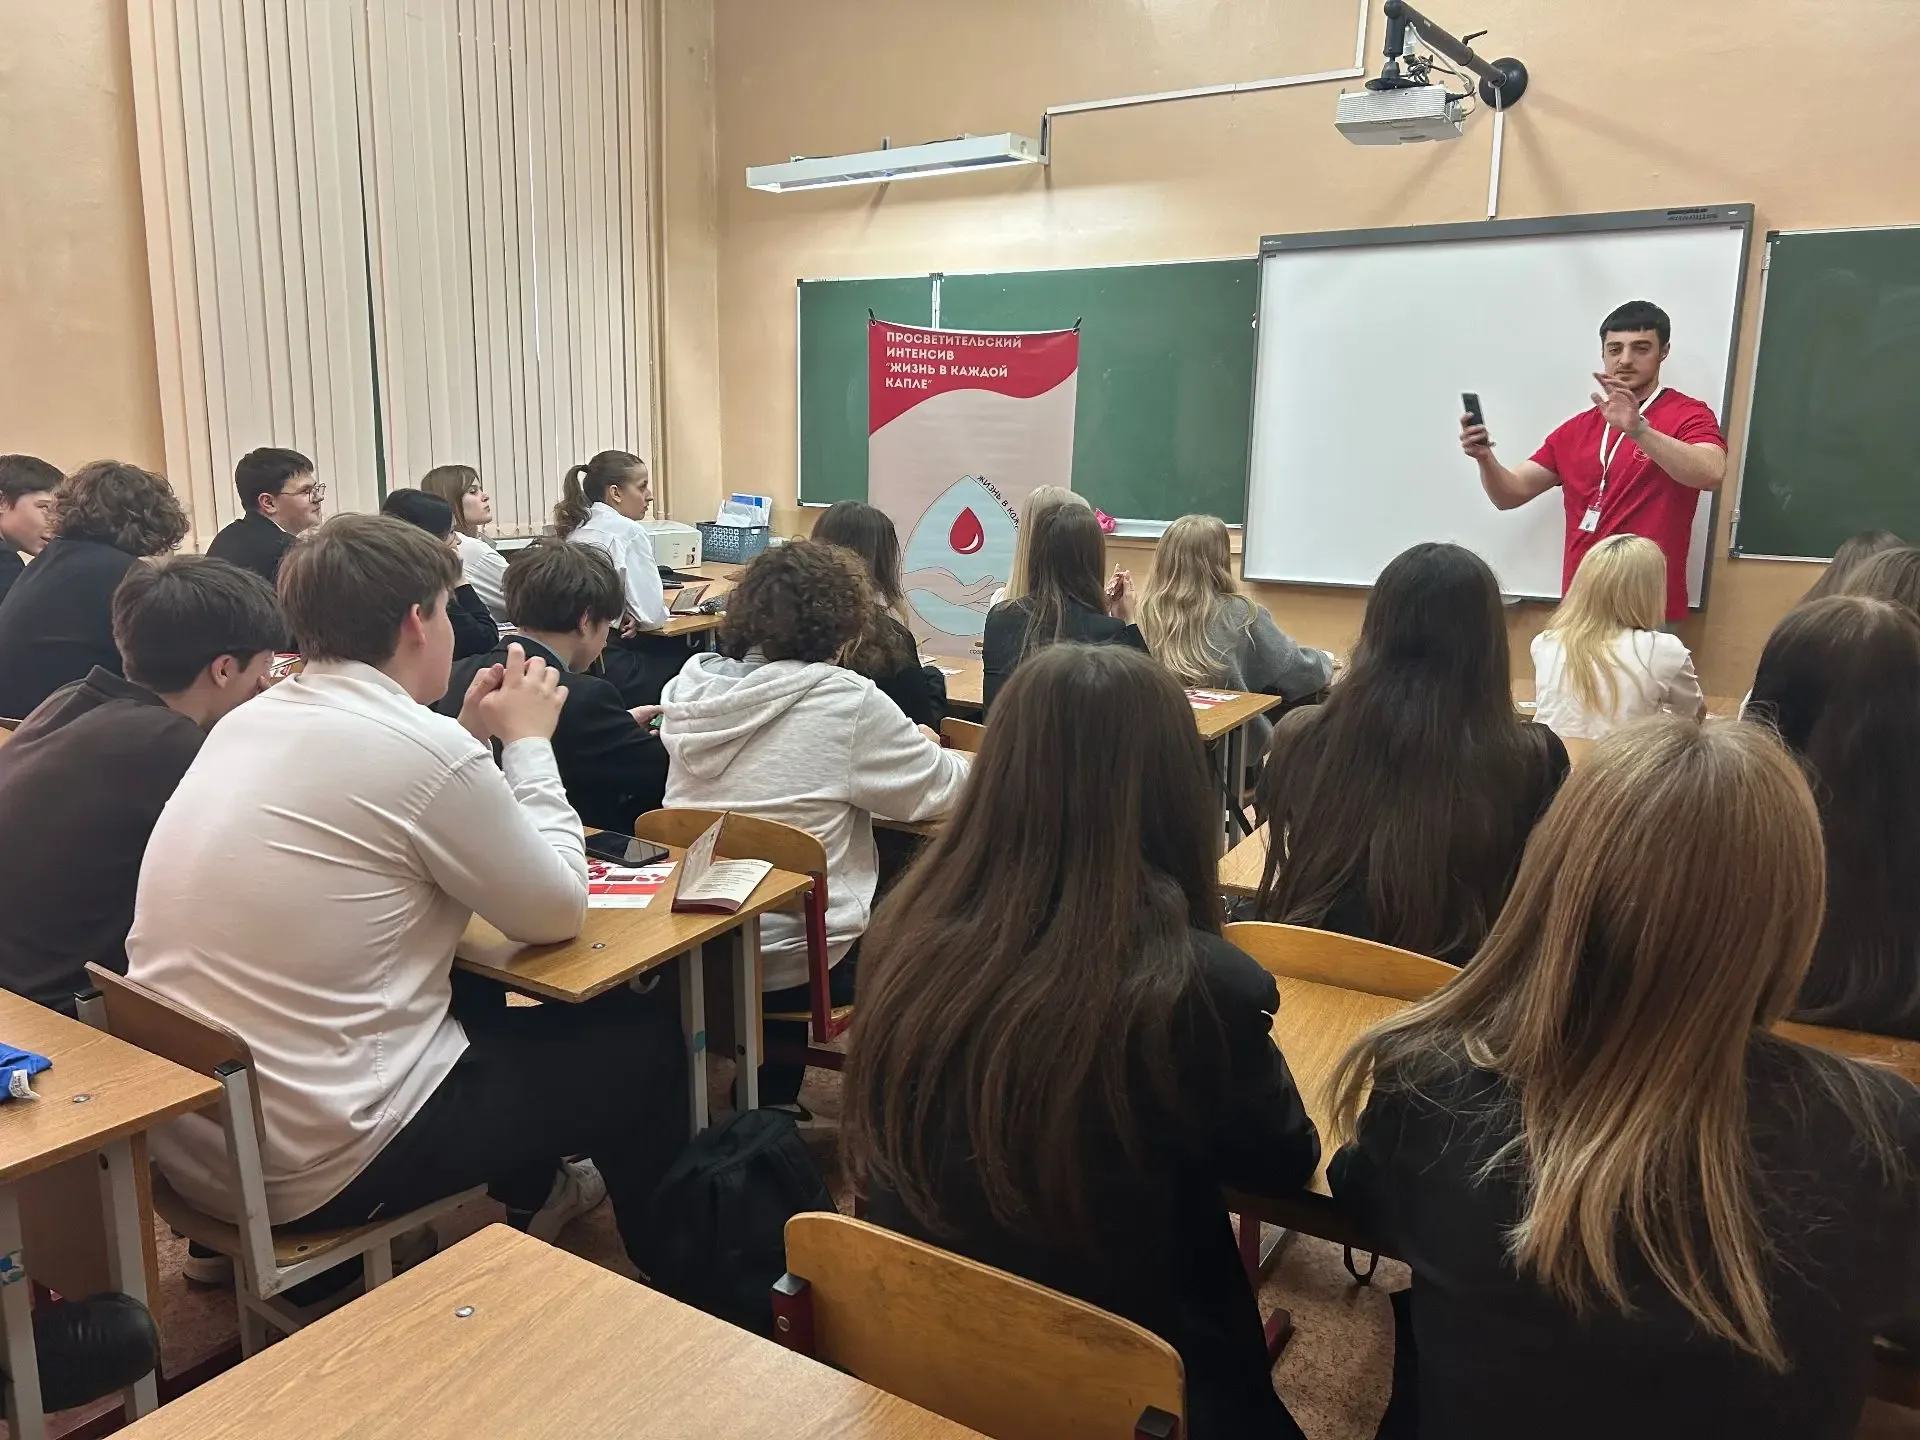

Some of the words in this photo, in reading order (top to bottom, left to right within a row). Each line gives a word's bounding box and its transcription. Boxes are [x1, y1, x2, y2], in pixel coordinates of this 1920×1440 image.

[886, 331, 1022, 348] ПРОСВЕТИТЕЛЬСКИЙ
[886, 346, 955, 361] ИНТЕНСИВ
[939, 364, 947, 375] В
[950, 364, 1008, 378] КАЖДОЙ
